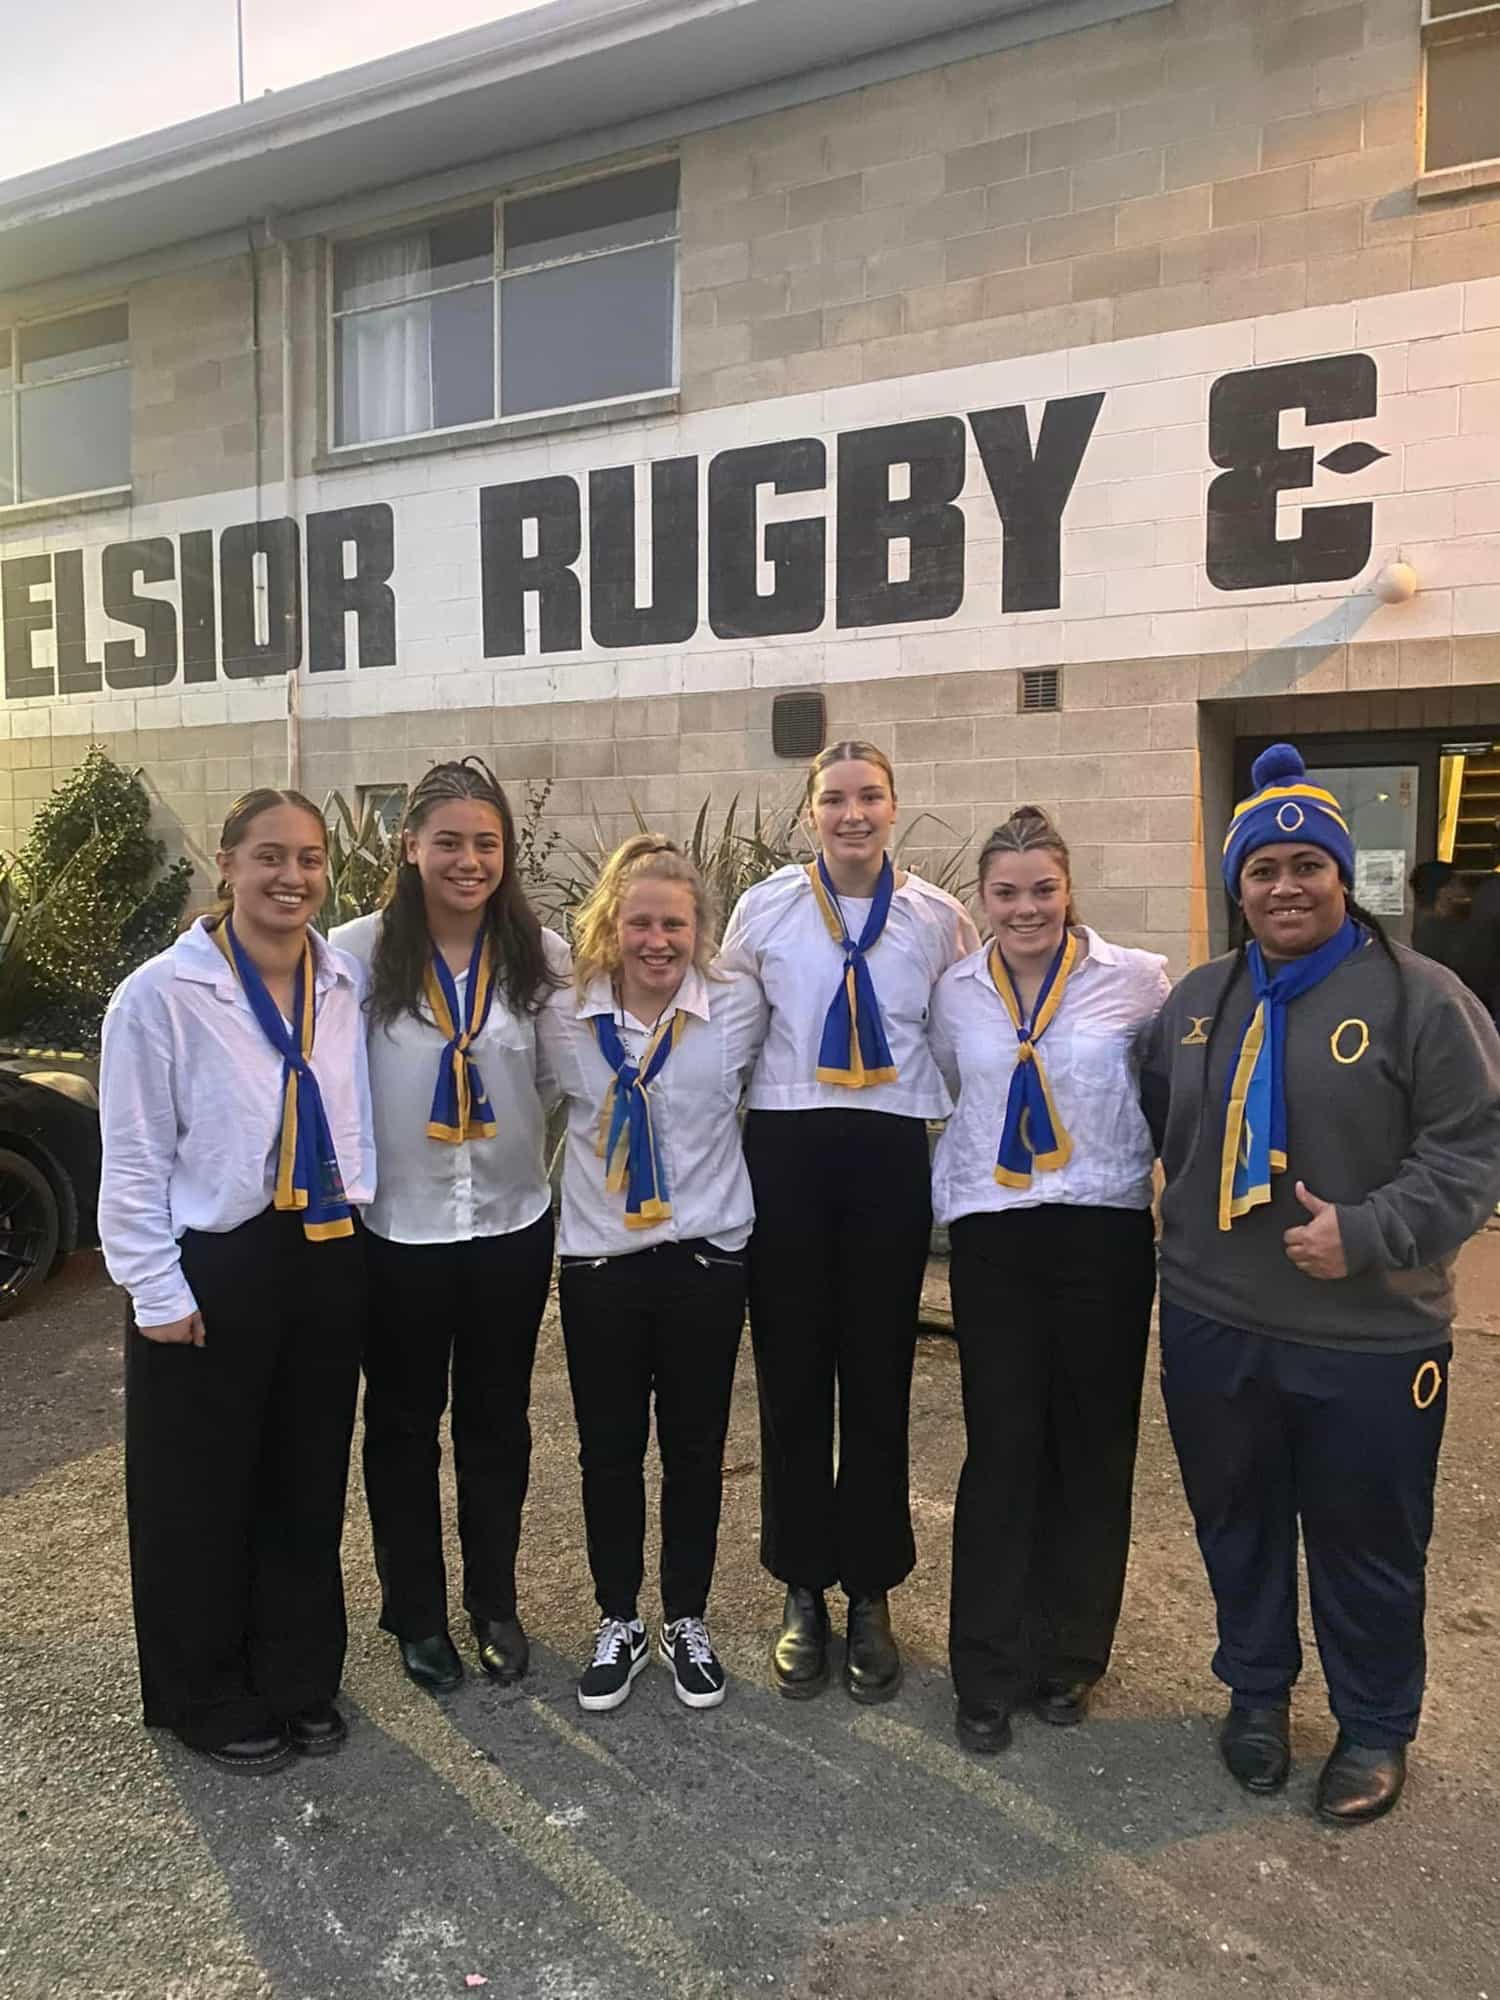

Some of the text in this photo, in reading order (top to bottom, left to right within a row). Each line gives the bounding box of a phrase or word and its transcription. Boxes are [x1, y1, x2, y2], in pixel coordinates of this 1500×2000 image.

[2, 352, 1391, 699] ELSIOR RUGBY &
